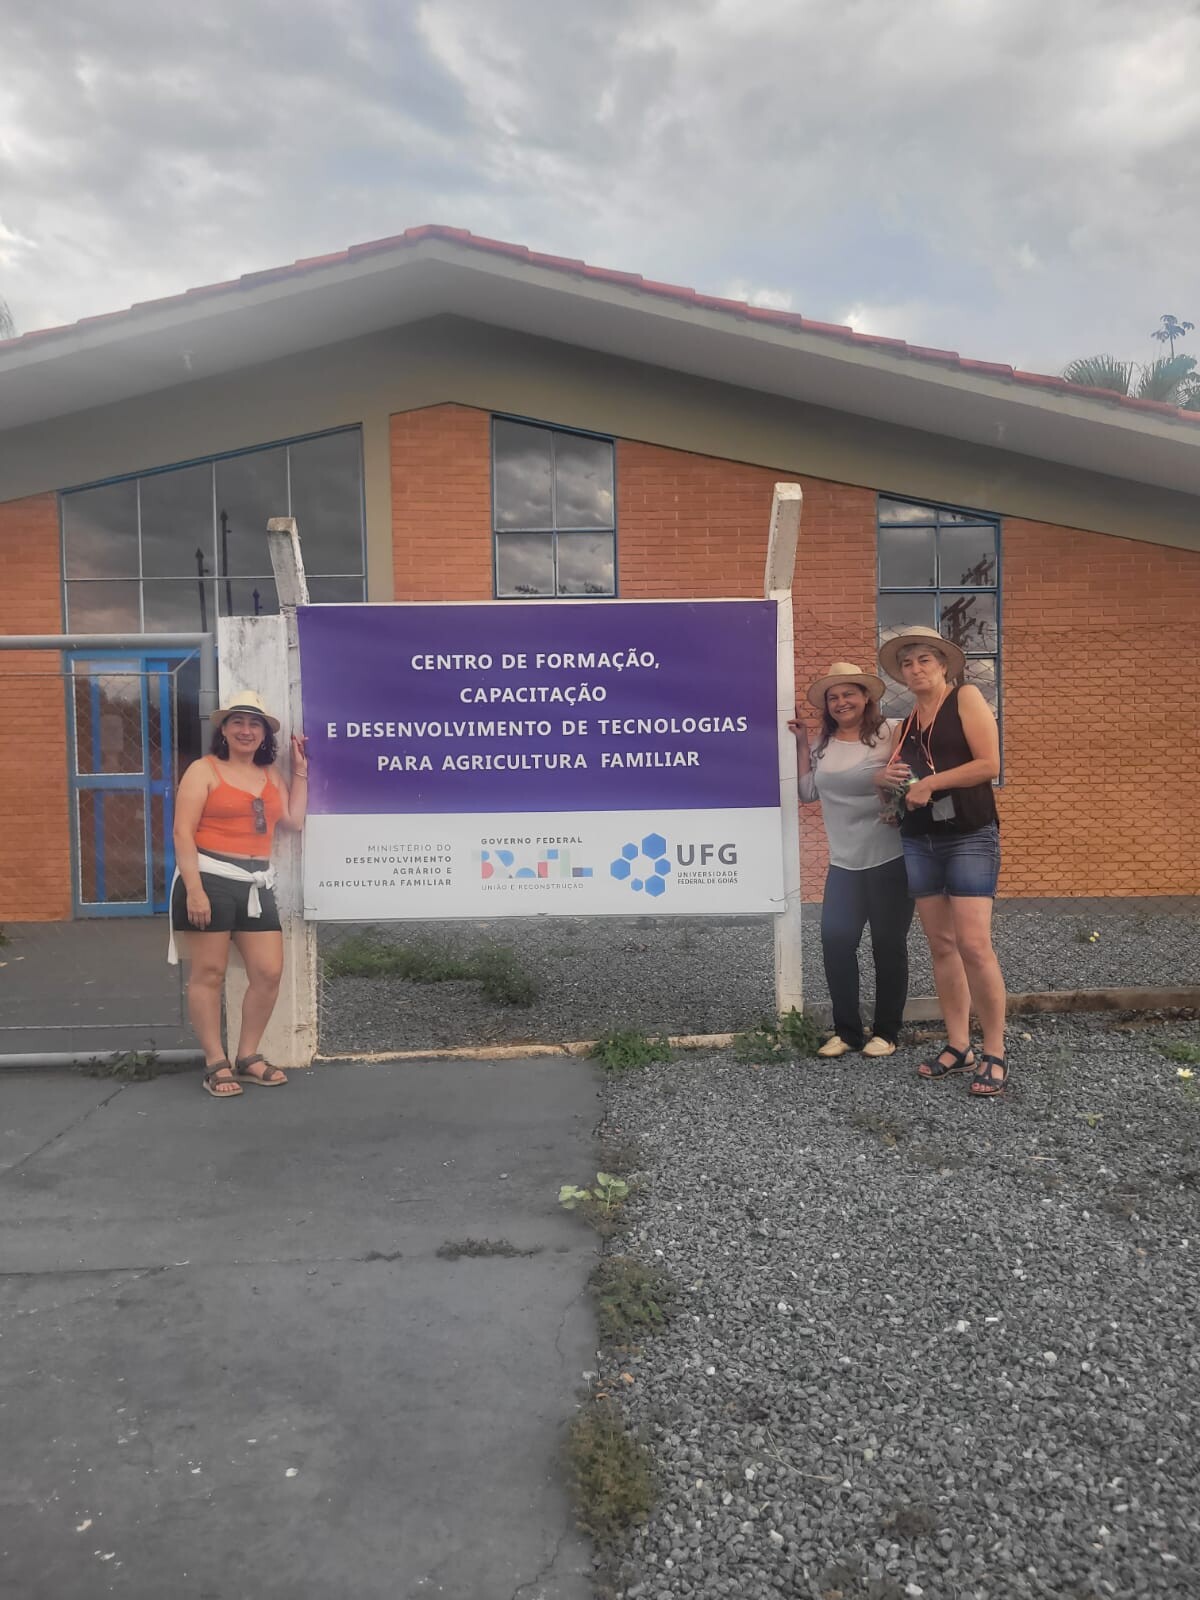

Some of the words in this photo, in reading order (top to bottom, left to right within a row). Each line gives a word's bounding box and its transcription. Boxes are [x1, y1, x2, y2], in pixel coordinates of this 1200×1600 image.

[411, 655, 493, 669] CENTRO
[502, 654, 527, 668] DE
[536, 648, 660, 671] FORMAÇÃO,
[460, 683, 607, 705] CAPACITAÇÃO
[327, 723, 337, 737] E
[346, 721, 552, 737] DESENVOLVIMENTO
[562, 721, 588, 735] DE
[597, 717, 748, 734] TECNOLOGIAS
[377, 756, 433, 770] PARA
[441, 754, 588, 770] AGRICULTURA
[601, 752, 700, 767] FAMILIAR
[535, 836, 583, 844] FEDERAL
[345, 856, 452, 864] DESENVOLVIMENTO
[676, 843, 738, 866] UFG
[392, 866, 442, 875] AGRÁRIO
